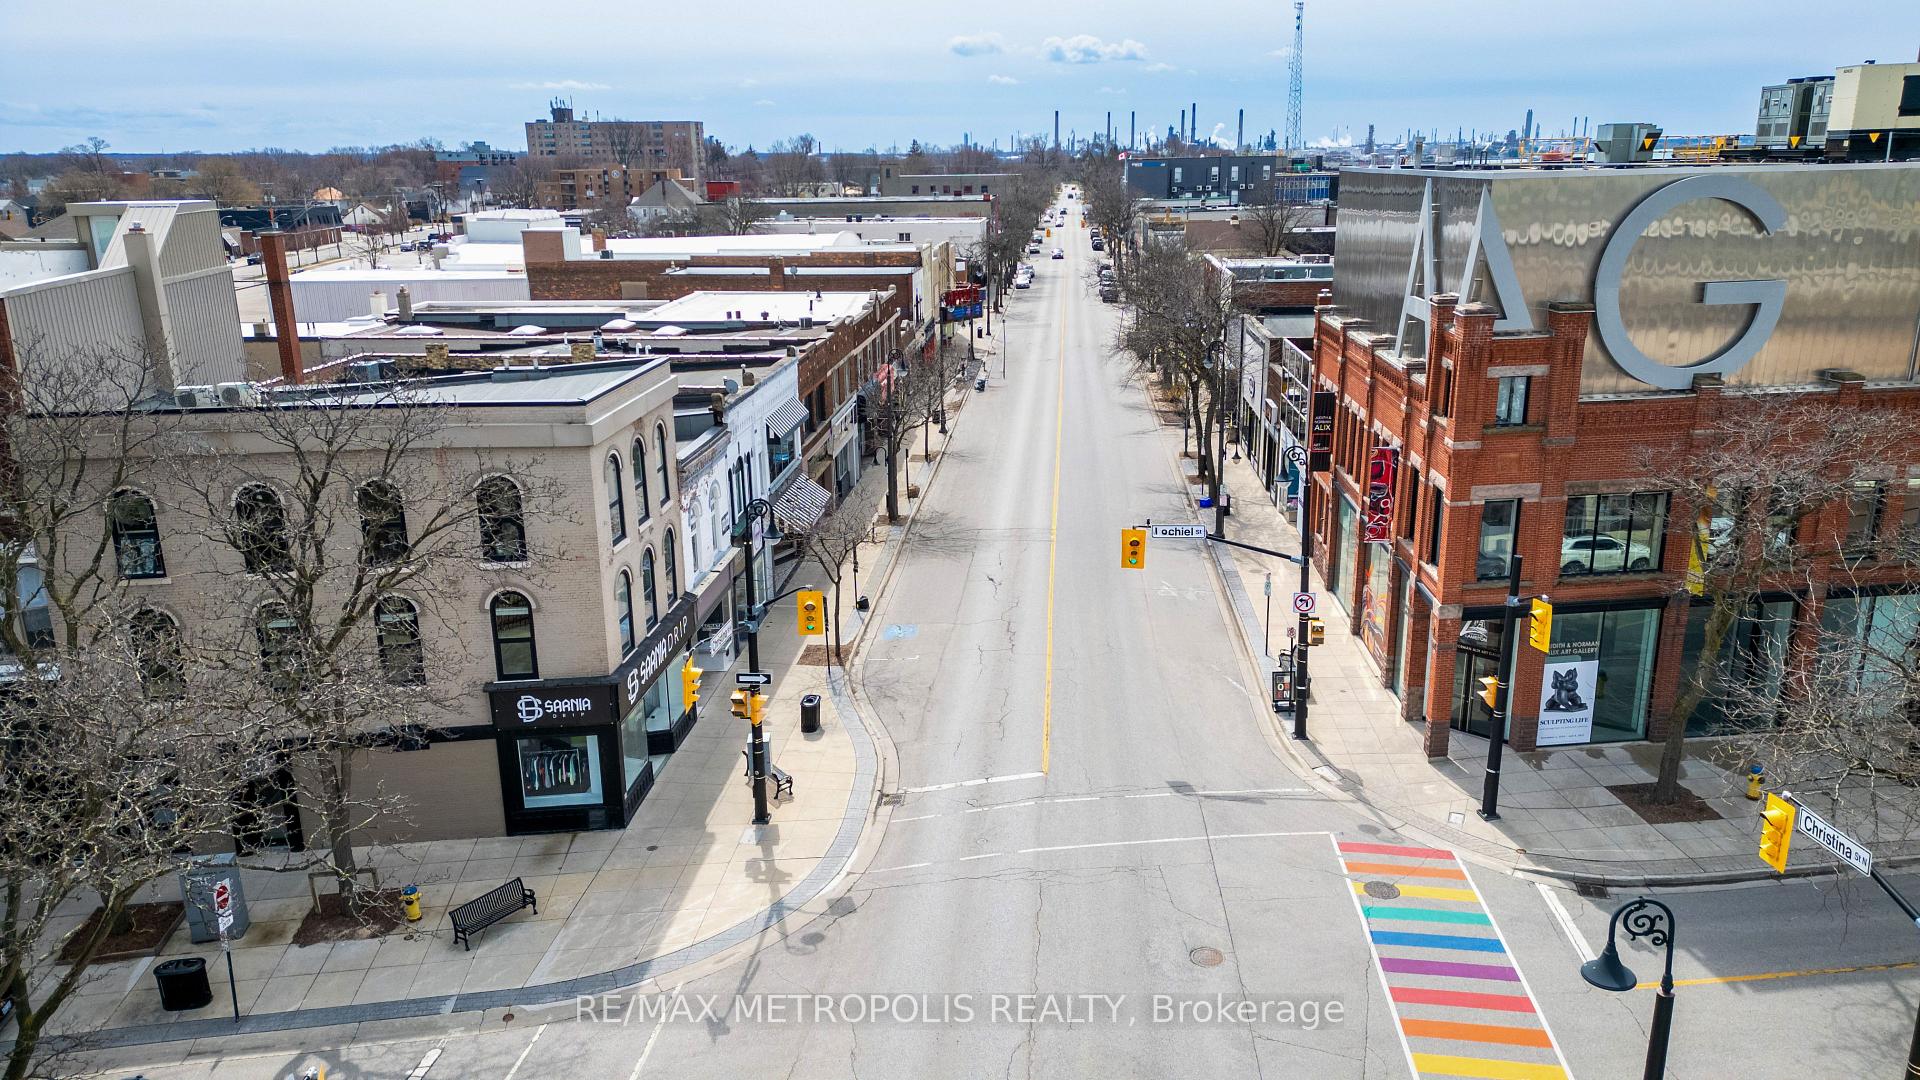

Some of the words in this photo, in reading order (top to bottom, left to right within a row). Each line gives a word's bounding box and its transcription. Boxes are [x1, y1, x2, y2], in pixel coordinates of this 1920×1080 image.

[640, 638, 667, 684] SARNIA
[668, 616, 688, 652] DRIP
[545, 698, 592, 712] SARNIA
[1804, 816, 1852, 860] Christina
[1854, 852, 1861, 862] St
[1863, 857, 1868, 866] N
